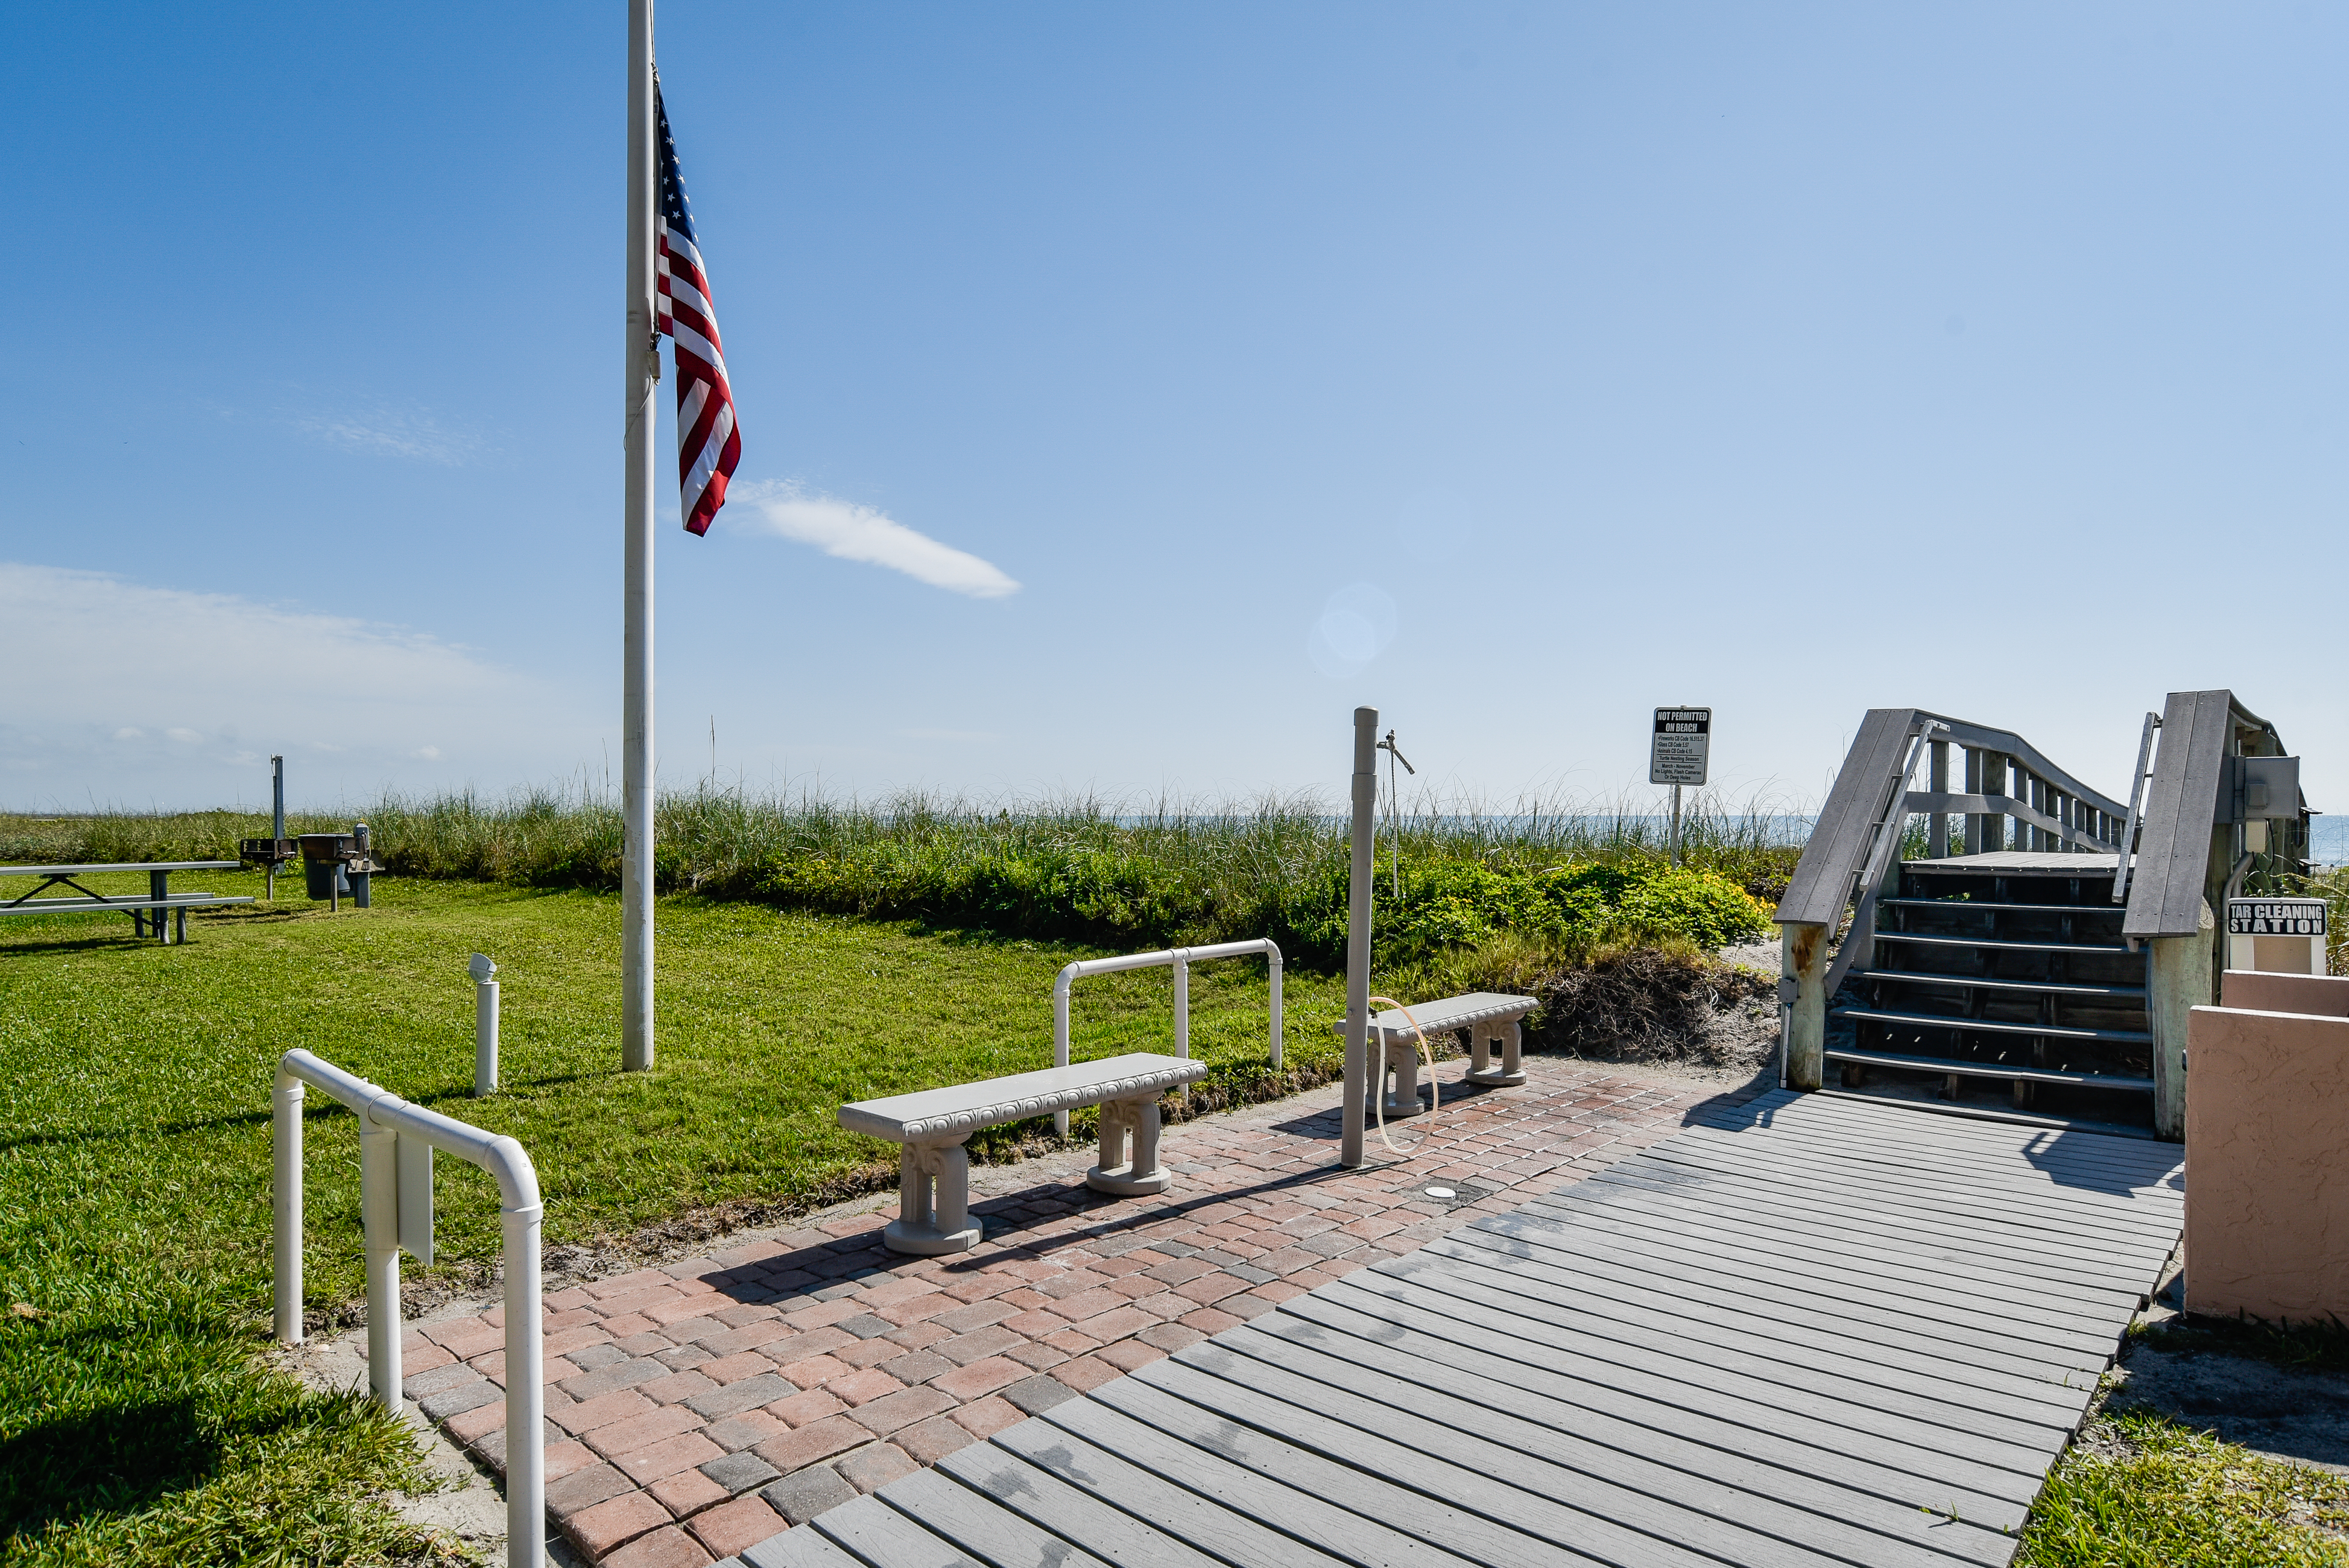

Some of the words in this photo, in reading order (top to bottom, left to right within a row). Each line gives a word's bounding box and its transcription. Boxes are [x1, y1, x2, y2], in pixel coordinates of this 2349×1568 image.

[1658, 712, 1671, 720] NOT
[1671, 712, 1707, 721] PERMITTED
[1666, 723, 1675, 732] ON
[1676, 723, 1697, 732] BEACH
[2231, 905, 2251, 918] TAR
[2254, 905, 2322, 919] CLEANING
[2231, 919, 2322, 933] STATION
